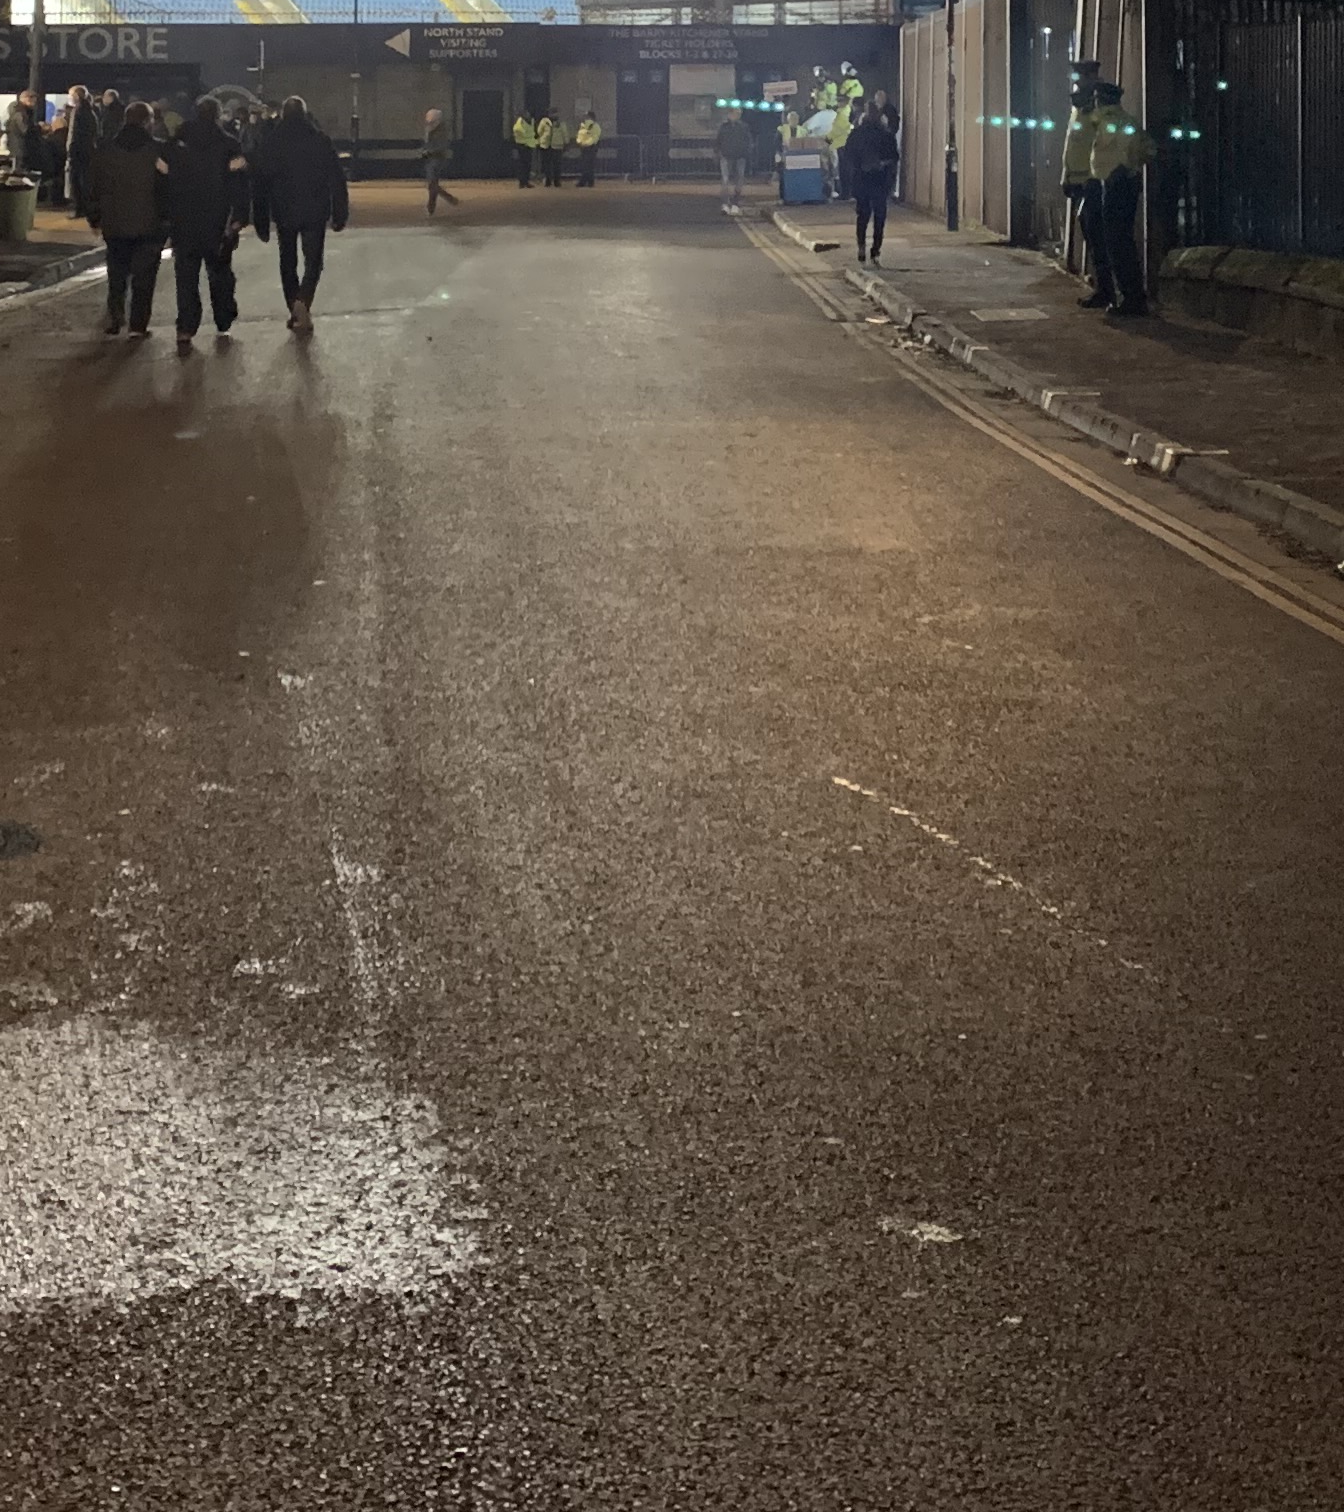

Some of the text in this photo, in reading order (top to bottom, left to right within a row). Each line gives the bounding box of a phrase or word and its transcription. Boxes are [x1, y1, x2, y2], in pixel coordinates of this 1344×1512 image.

[423, 27, 504, 37] NORTH STAND
[440, 38, 487, 47] VISITING
[429, 49, 498, 58] SUPPORTERS
